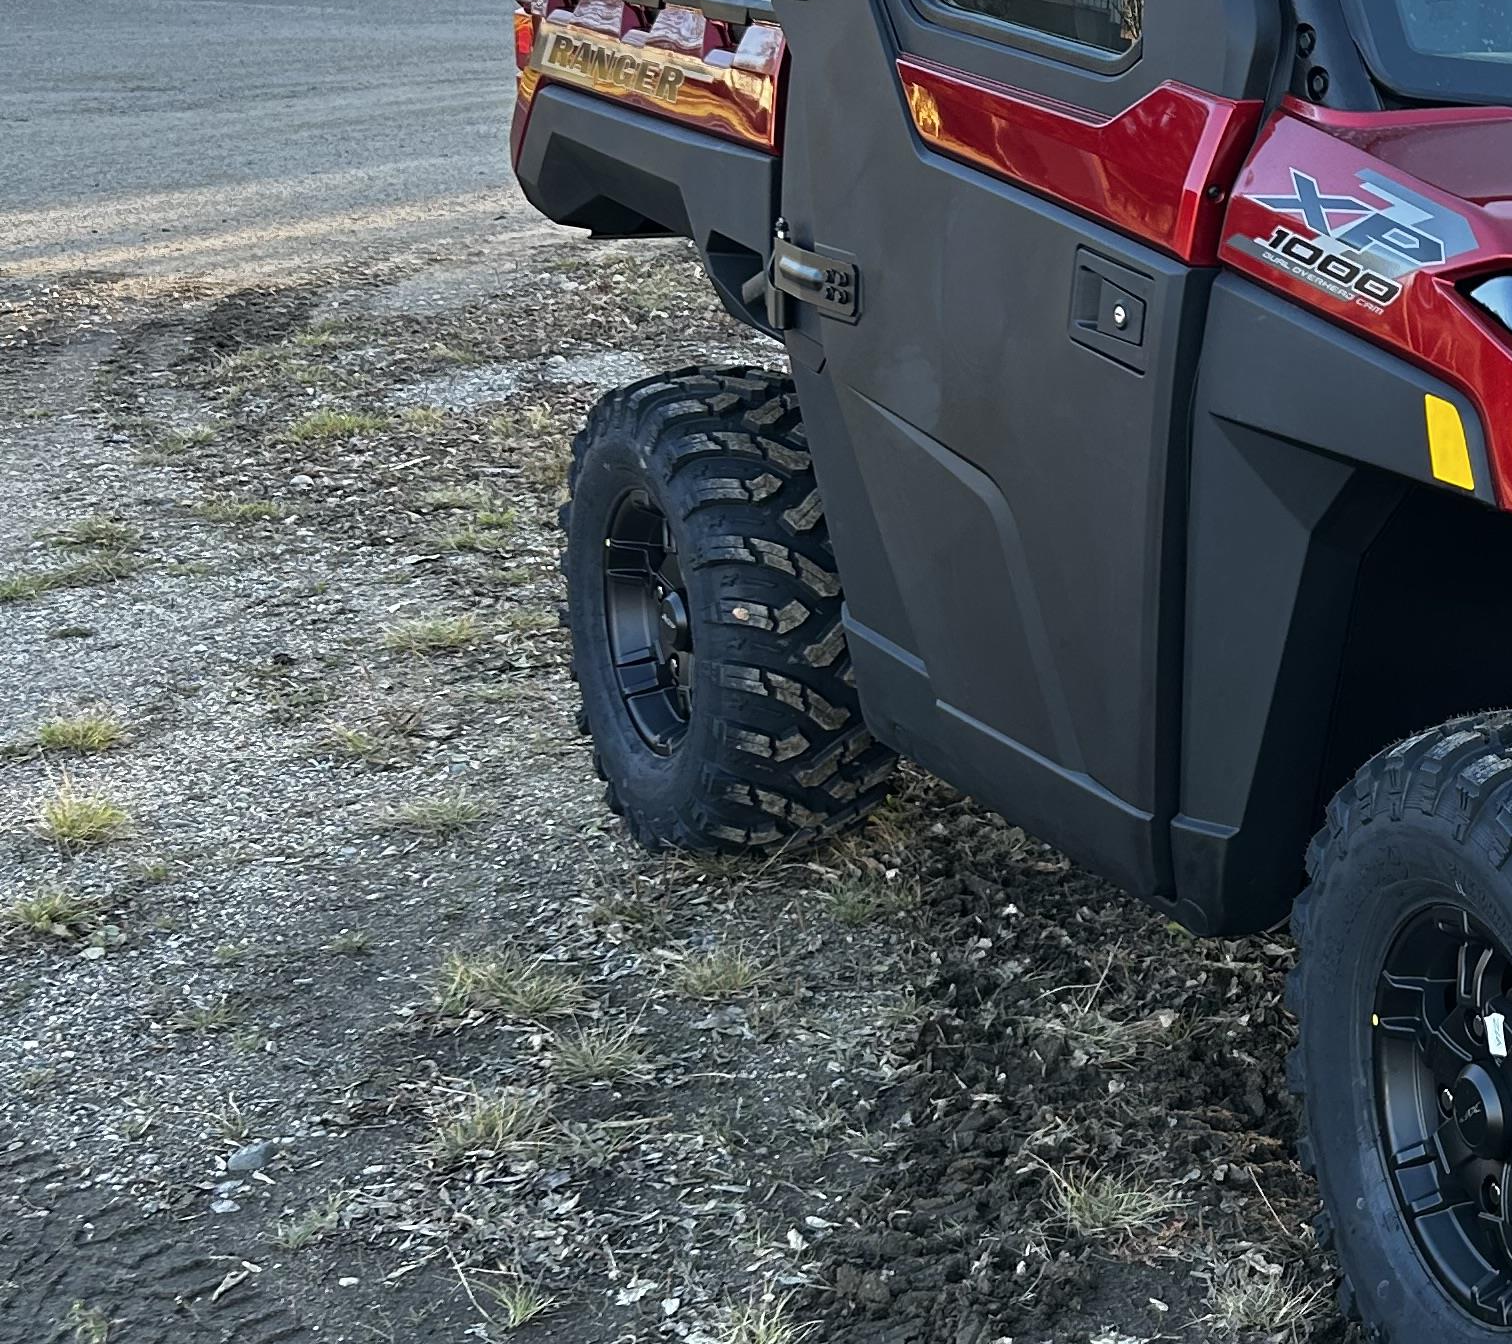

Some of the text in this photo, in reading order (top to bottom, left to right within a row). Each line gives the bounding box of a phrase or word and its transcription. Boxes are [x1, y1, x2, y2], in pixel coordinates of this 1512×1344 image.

[547, 34, 686, 104] RANGER
[1244, 166, 1446, 266] XP
[1259, 225, 1403, 306] 1000
[1261, 251, 1385, 316] DUAL OVERHEAD CAM
